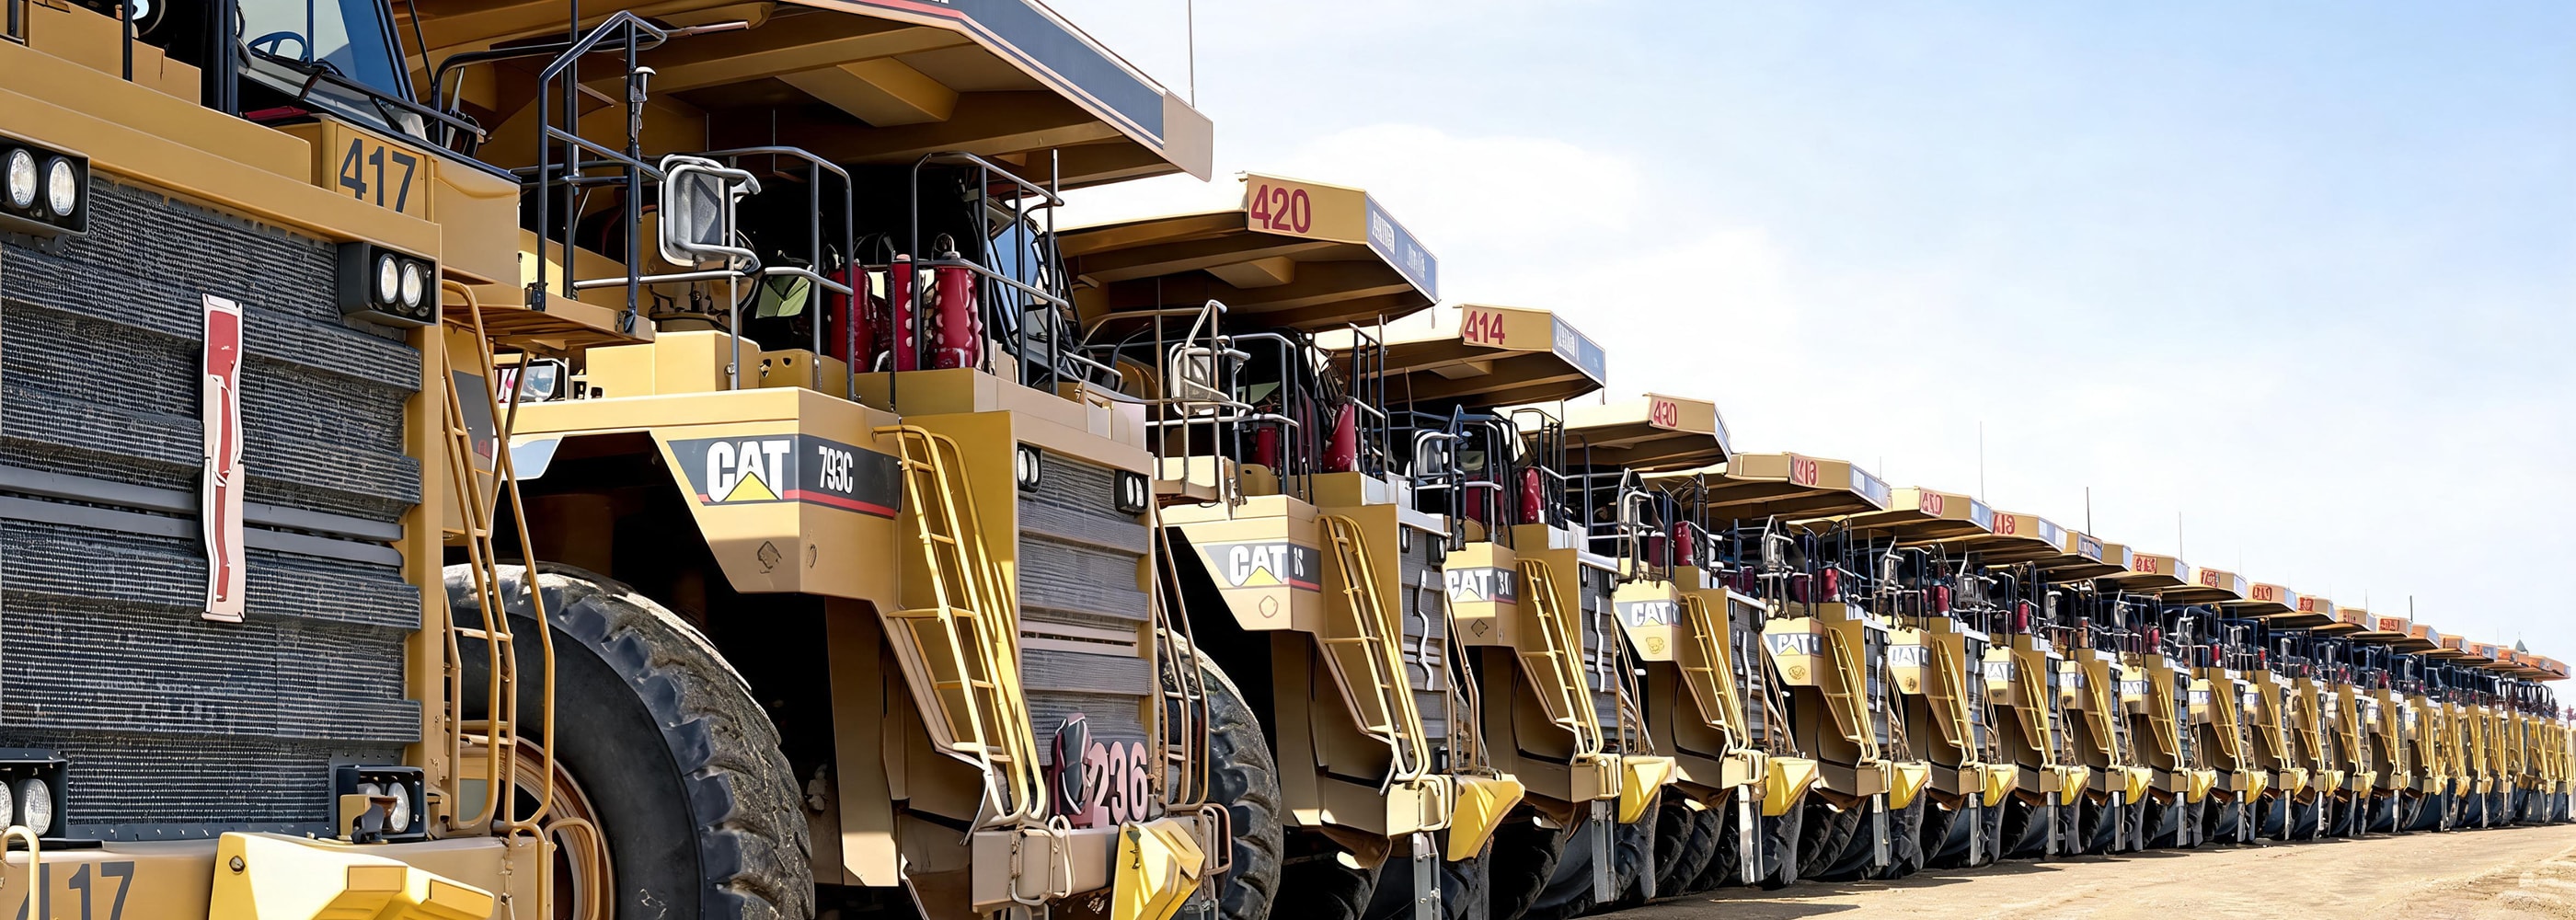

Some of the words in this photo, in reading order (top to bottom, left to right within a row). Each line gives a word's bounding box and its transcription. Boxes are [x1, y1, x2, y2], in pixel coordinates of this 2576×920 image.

[339, 138, 417, 213] 417
[1250, 184, 1311, 234] 420
[1464, 310, 1505, 345] 414
[707, 439, 791, 503] CAT
[818, 445, 854, 494] 793C
[1229, 545, 1288, 588] CAT
[1445, 569, 1493, 601] CAT
[1631, 602, 1672, 627] CAT
[1087, 741, 1149, 829] 236
